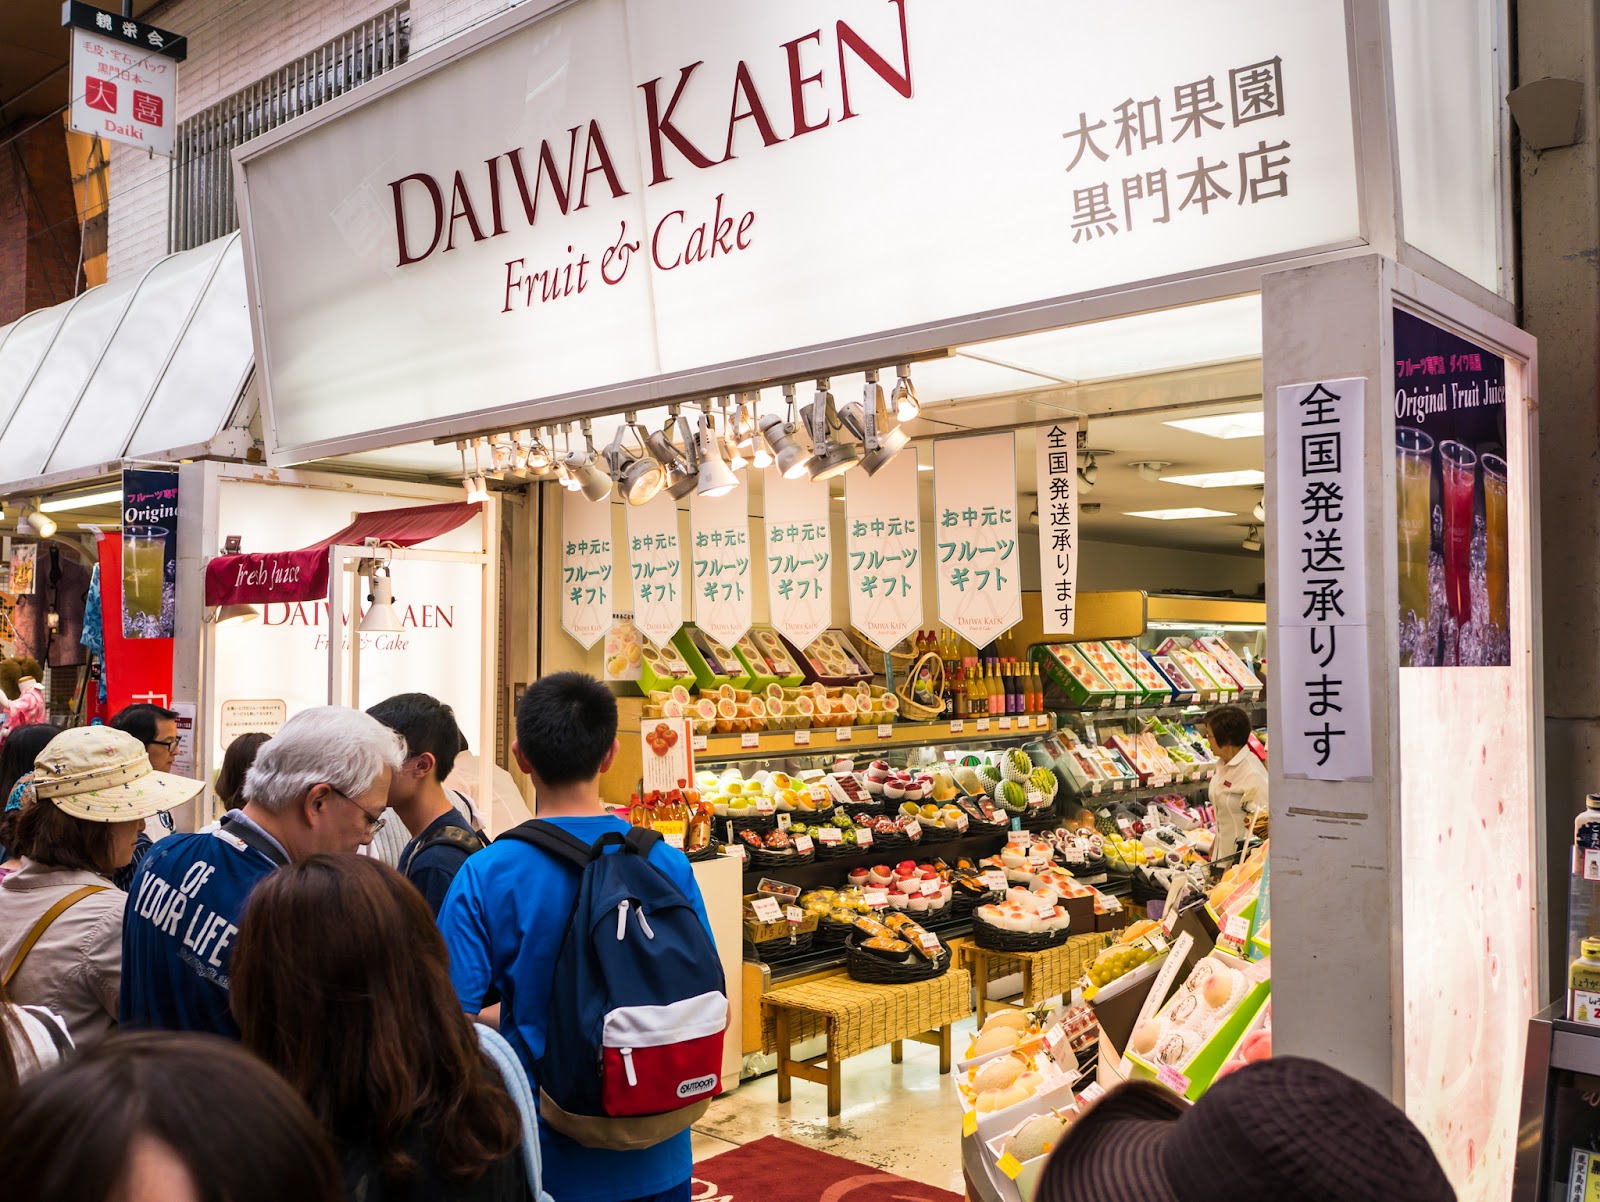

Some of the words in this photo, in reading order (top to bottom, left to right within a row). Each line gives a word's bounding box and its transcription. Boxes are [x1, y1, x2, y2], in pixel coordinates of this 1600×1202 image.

[1062, 55, 1285, 173] 大和果園
[104, 119, 144, 140] Daiki
[387, 119, 629, 268] DAIWA
[637, 0, 915, 187] KAEN
[1070, 139, 1291, 244] 黒門本店
[501, 245, 590, 314] Fruit
[601, 220, 640, 286] &
[651, 193, 755, 272] Cake
[1395, 383, 1447, 423] Original
[1451, 381, 1480, 410] Fruit
[851, 516, 915, 537] お中元に
[941, 505, 1012, 527] お中元に
[1047, 425, 1073, 627] 全国発送承ります
[632, 533, 677, 551] お中元に
[696, 529, 746, 548] お中元に
[770, 523, 826, 543] お中元に
[566, 539, 610, 555] お中元に
[938, 539, 1014, 563] フルーツ
[631, 559, 680, 580] フルーツ
[694, 557, 749, 578] フルーツ
[768, 552, 829, 575] フルーツ
[850, 548, 917, 571] フルーツ
[563, 565, 612, 583] フルーツ
[949, 567, 1007, 592] ギフト
[1299, 383, 1346, 767] 全国発送承ります
[570, 587, 607, 606] ギフト
[640, 582, 677, 602] ギフト
[703, 581, 745, 602] ギフト
[777, 577, 823, 600] ギフト
[860, 574, 912, 598] ギフト
[402, 604, 454, 628] AEN
[958, 617, 981, 625] DAIWA
[984, 617, 1003, 625] KAEN
[375, 634, 409, 650] Cake
[180, 860, 215, 899] OF
[134, 870, 187, 936] YOUR
[183, 904, 239, 968] LIFE
